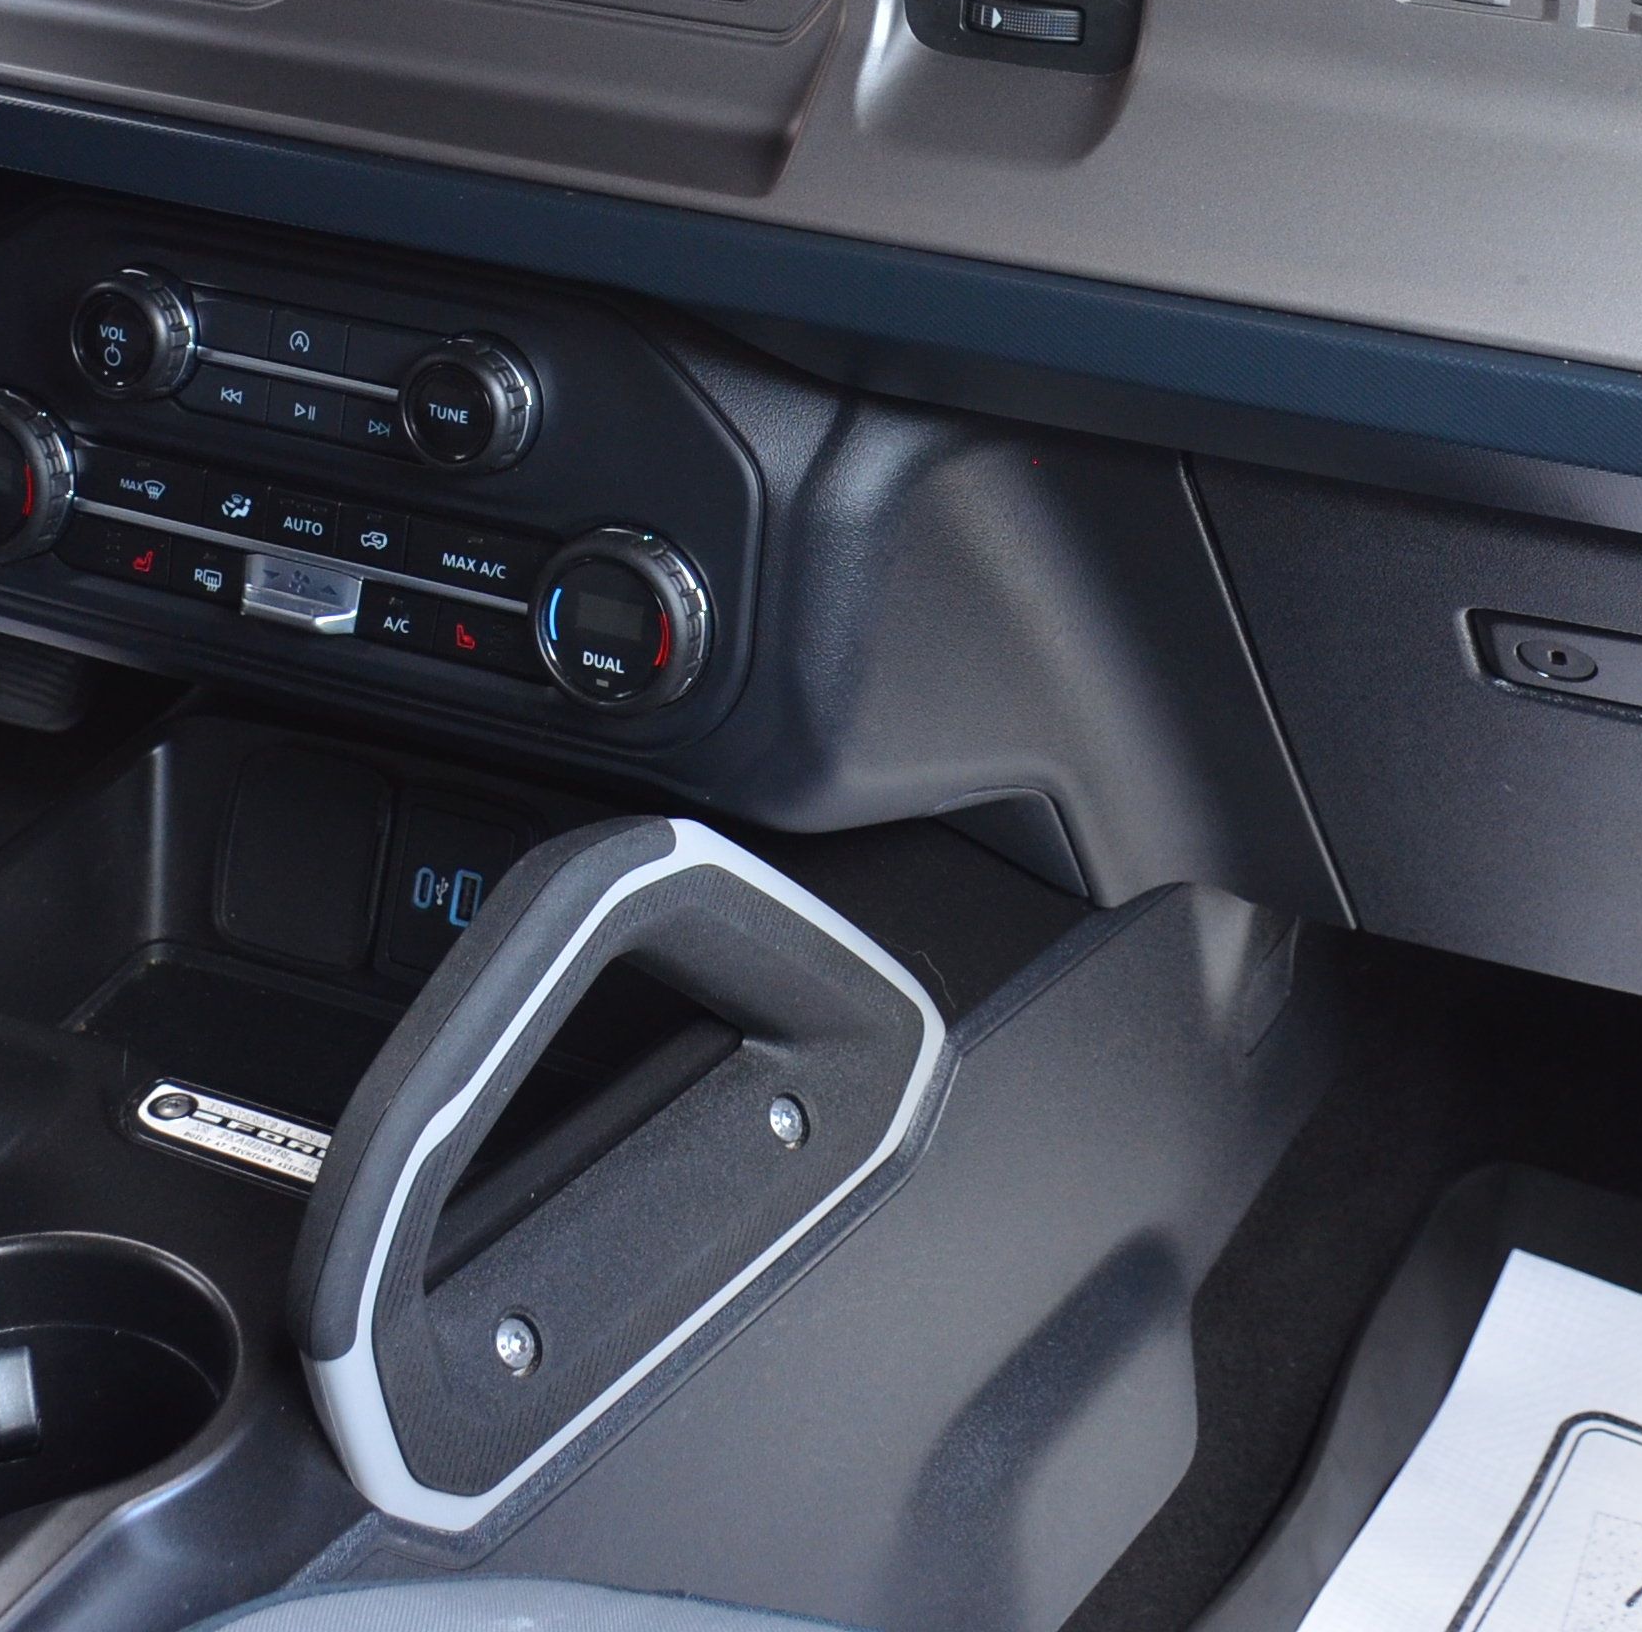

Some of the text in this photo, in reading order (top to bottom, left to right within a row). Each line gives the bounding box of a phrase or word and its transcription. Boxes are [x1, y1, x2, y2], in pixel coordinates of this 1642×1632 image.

[99, 324, 127, 343] VOL
[428, 403, 469, 424] TUNE
[119, 478, 144, 492] MAX
[283, 516, 323, 536] AUTO
[442, 552, 507, 580] MAX A/C
[383, 616, 410, 634] A/C
[582, 651, 625, 674] DUAL
